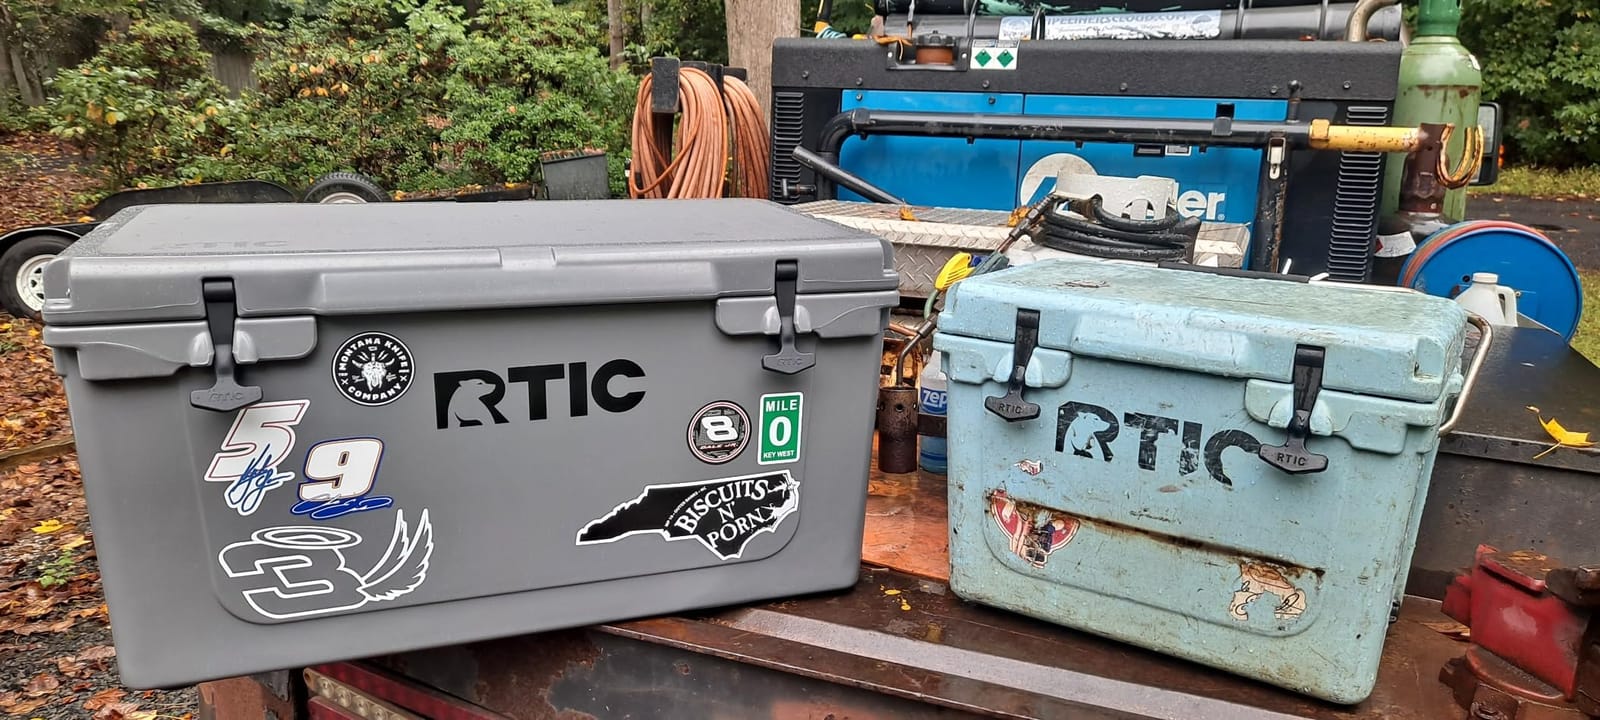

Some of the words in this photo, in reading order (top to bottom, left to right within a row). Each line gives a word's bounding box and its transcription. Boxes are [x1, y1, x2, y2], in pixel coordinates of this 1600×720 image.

[1047, 13, 1187, 25] IPELINERSCLOUD.COM
[338, 337, 381, 371] MONTANA
[384, 340, 408, 368] KNIFE
[347, 383, 402, 401] COMPANY
[434, 359, 647, 429] RTIC
[765, 399, 798, 413] MILE
[999, 403, 1023, 414] RTIC
[205, 398, 310, 482] 5
[701, 415, 739, 442] 8
[769, 416, 792, 446] 0
[1055, 400, 1262, 487] RTIC
[297, 436, 385, 503] 9
[763, 451, 777, 459] KEY
[777, 450, 795, 458] WEST
[1276, 452, 1307, 466] RTIC
[674, 479, 769, 534] BISCUITS
[717, 500, 736, 524] N'
[706, 507, 765, 549] PORN
[218, 540, 371, 619] 3
